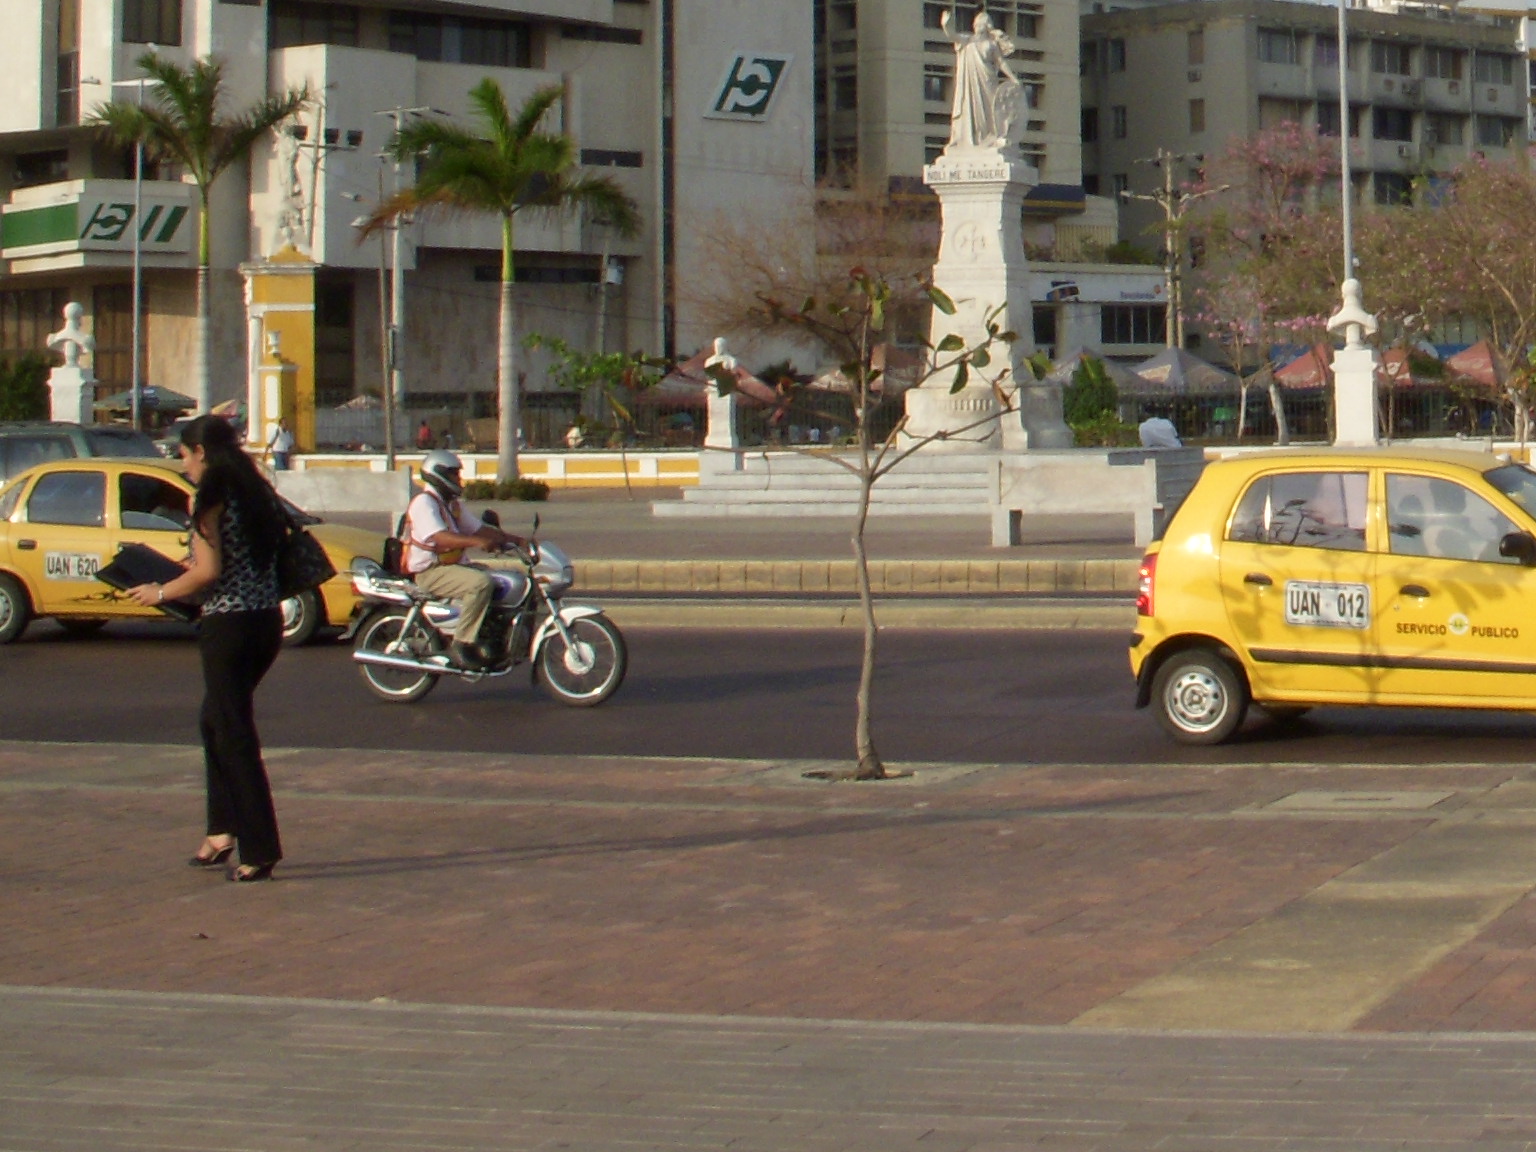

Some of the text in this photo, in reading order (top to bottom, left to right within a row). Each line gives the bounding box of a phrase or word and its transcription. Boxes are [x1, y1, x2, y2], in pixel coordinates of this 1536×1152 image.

[47, 557, 98, 576] UAN 620
[1290, 591, 1364, 618] UAN 012
[1396, 623, 1519, 638] SERVICIO PUBLICO
